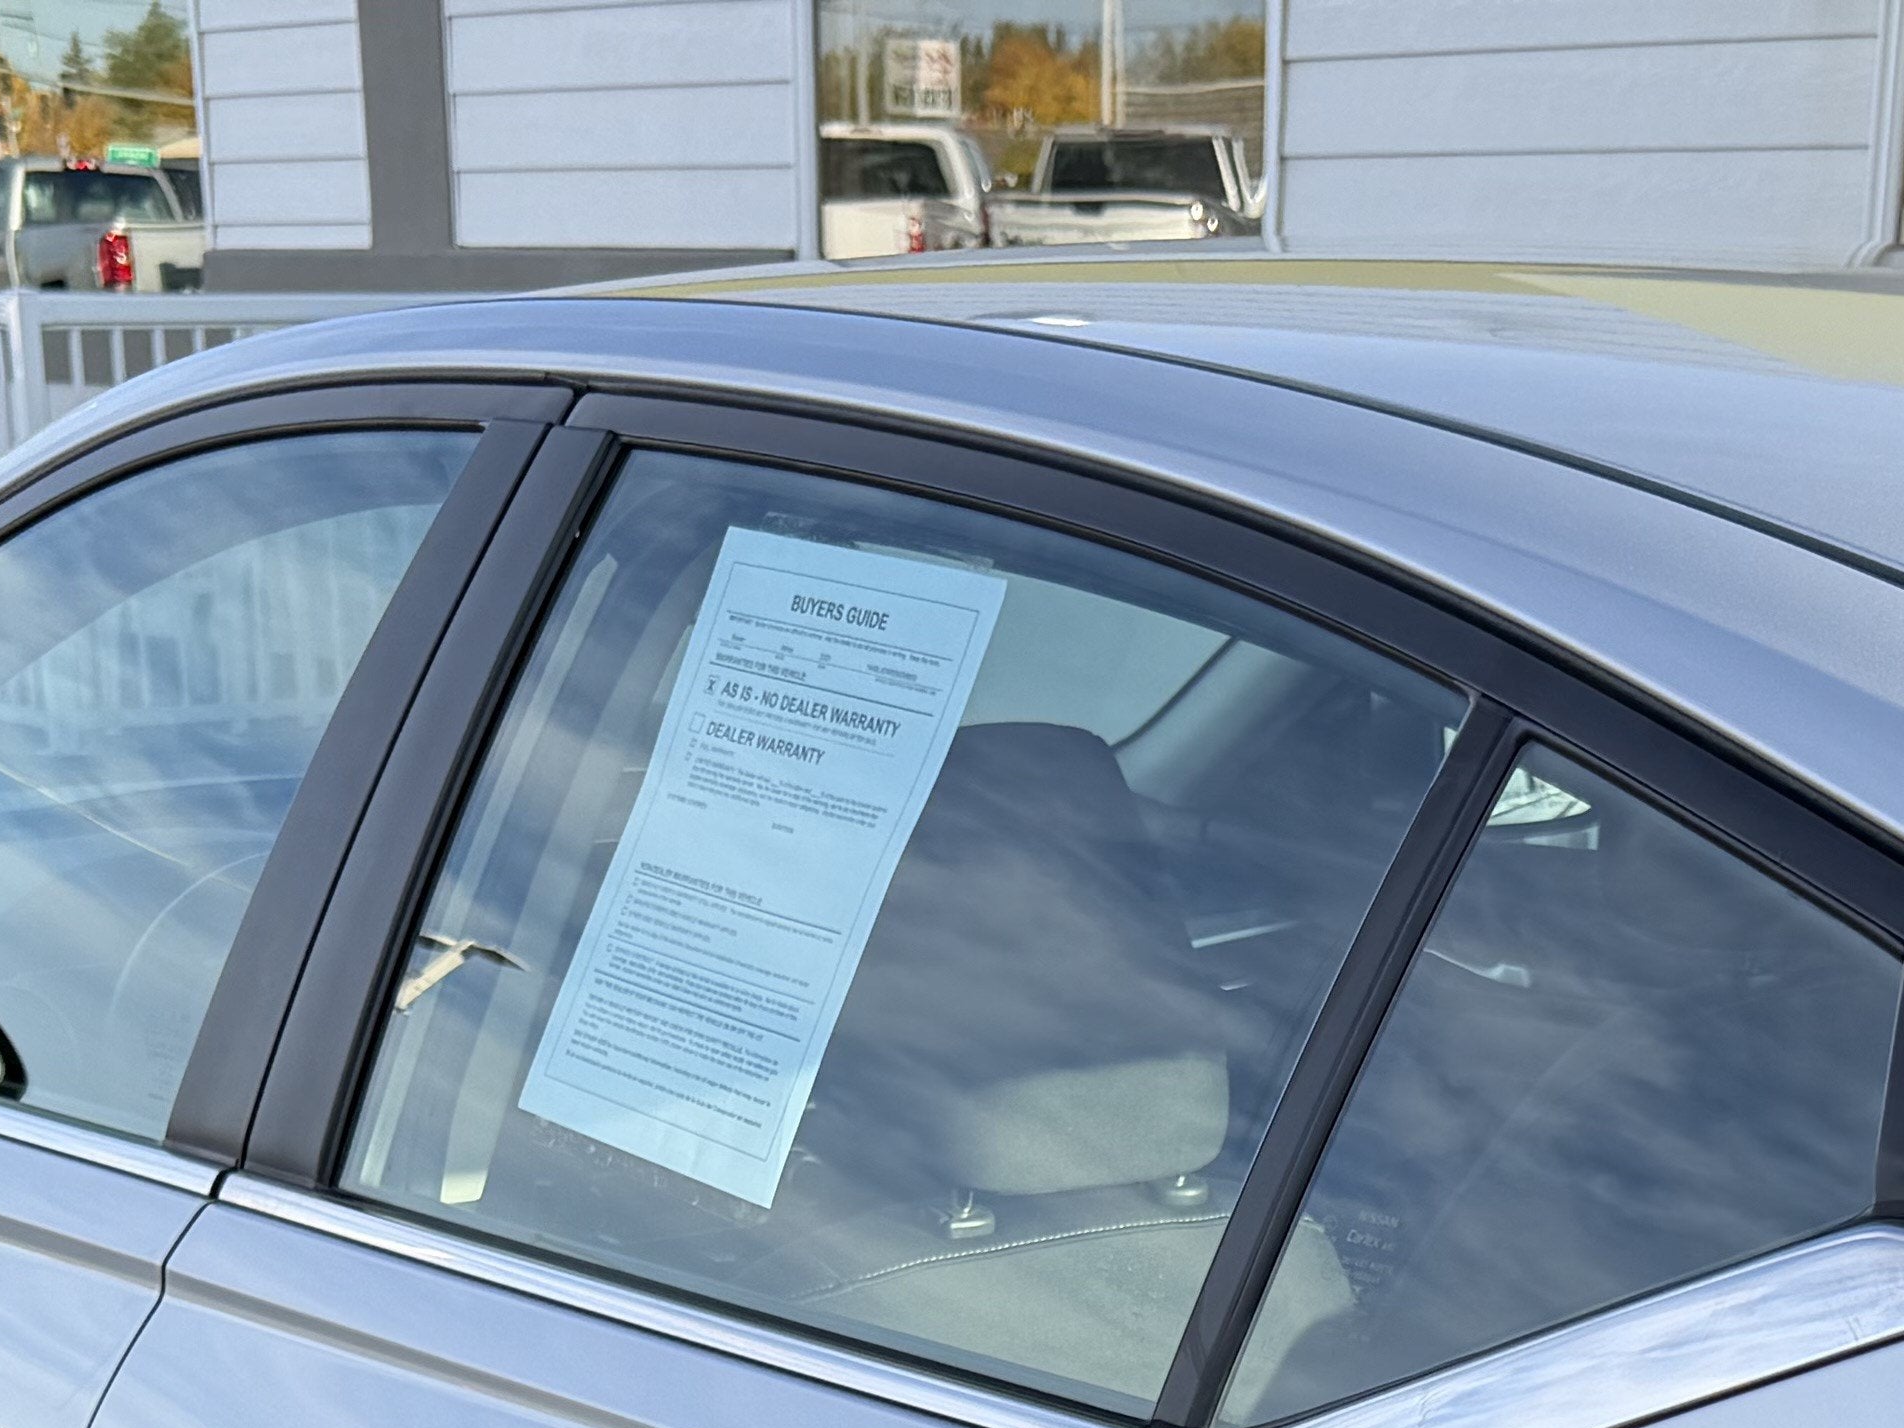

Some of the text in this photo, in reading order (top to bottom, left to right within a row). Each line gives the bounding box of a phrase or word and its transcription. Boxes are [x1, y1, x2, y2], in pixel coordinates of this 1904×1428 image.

[791, 594, 890, 631] BUYERS GUIDE
[721, 680, 739, 699] AS
[740, 684, 753, 702] IS
[760, 689, 780, 711] NO
[779, 695, 830, 723] DEALER
[830, 707, 902, 738] WARRANTY
[705, 721, 756, 747] DEALER
[756, 734, 826, 766] WARRANTY
